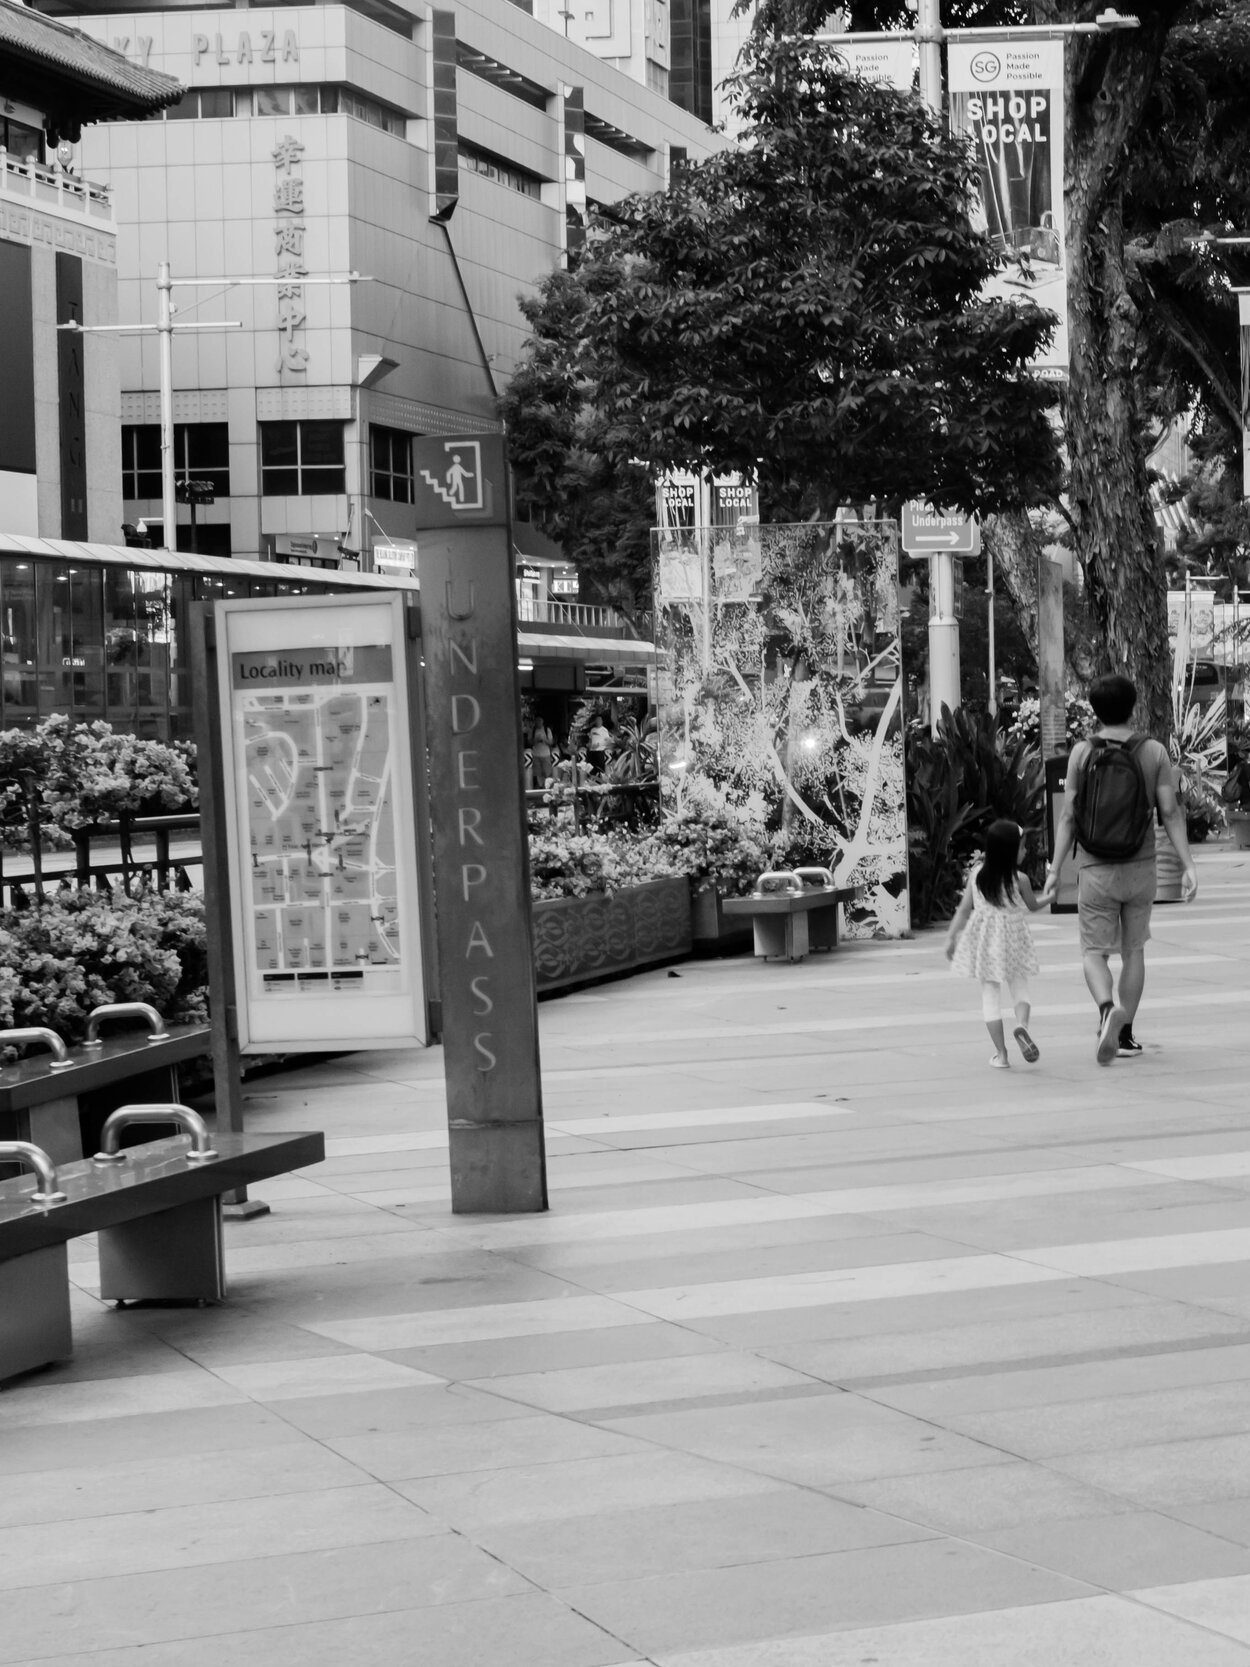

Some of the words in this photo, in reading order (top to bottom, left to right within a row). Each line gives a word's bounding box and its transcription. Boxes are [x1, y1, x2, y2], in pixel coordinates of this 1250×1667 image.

[193, 30, 298, 66] PLAZA
[974, 60, 997, 74] SG
[1006, 62, 1030, 70] Made
[1006, 72, 1043, 80] Possible
[967, 97, 1047, 120] SHOP
[662, 487, 694, 498] SHOP
[719, 487, 752, 498] SHOP
[663, 499, 694, 507] LOCAL
[720, 498, 753, 508] LOCAL
[912, 514, 963, 529] Underpass
[240, 660, 304, 680] Locality
[309, 661, 347, 678] map
[445, 580, 497, 1072] UNDERPASS
